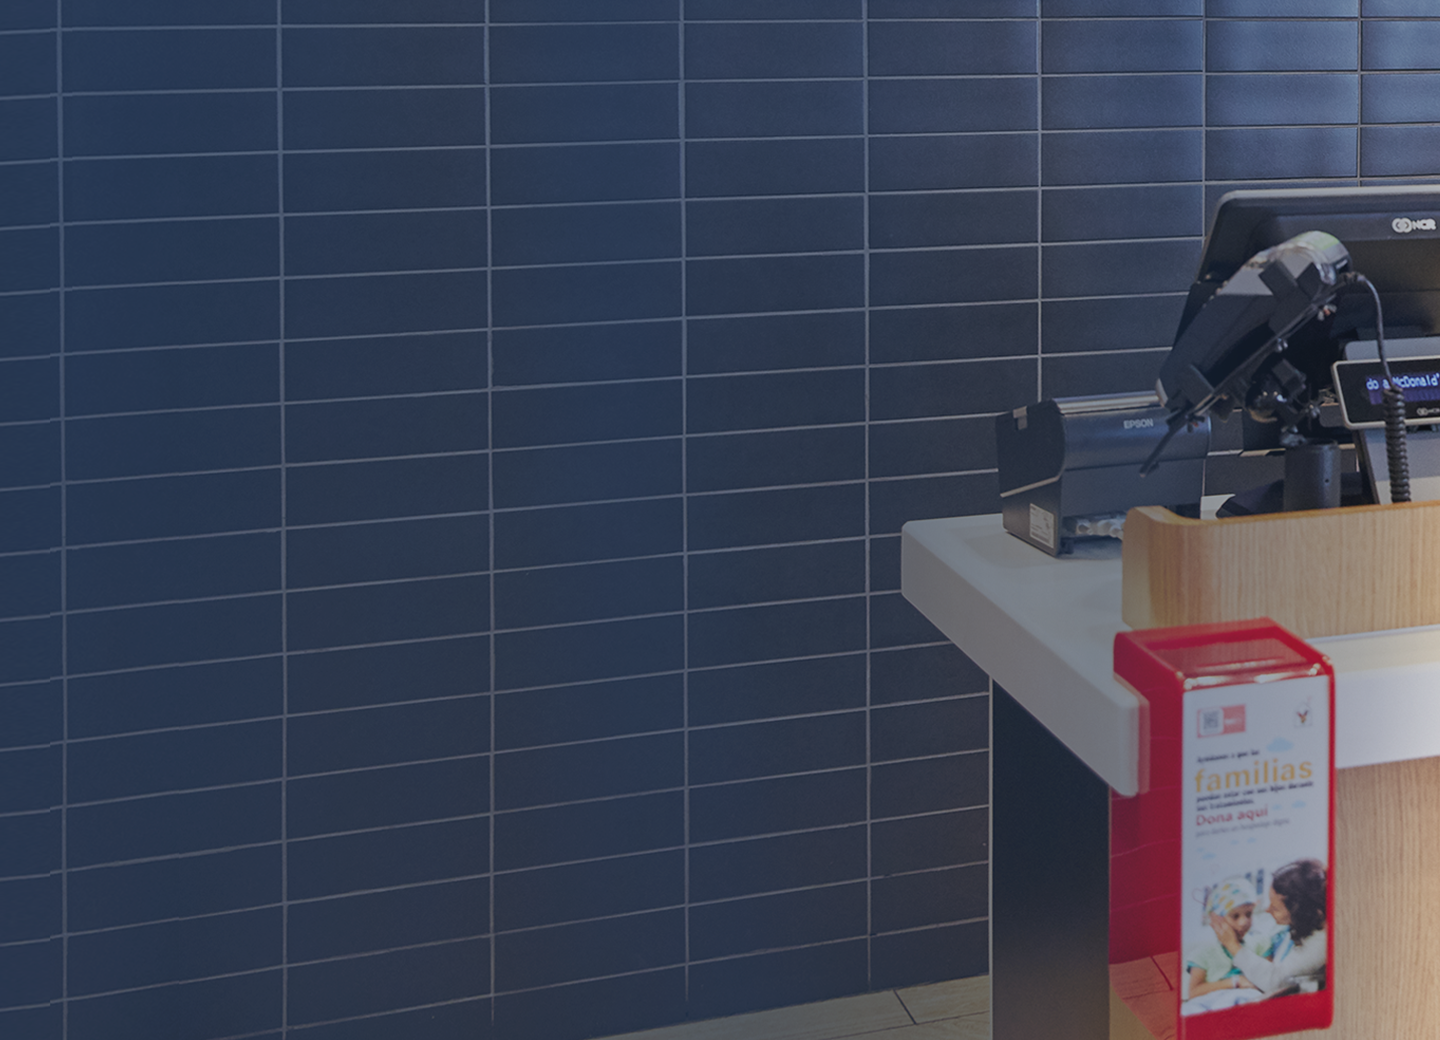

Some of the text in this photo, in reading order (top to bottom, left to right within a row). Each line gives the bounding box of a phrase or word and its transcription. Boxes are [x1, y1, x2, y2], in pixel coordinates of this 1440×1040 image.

[1366, 378, 1379, 390] do
[1383, 379, 1390, 390] a
[1123, 418, 1154, 429] EPSON
[1195, 758, 1313, 793] familias
[1196, 812, 1233, 826] Dona
